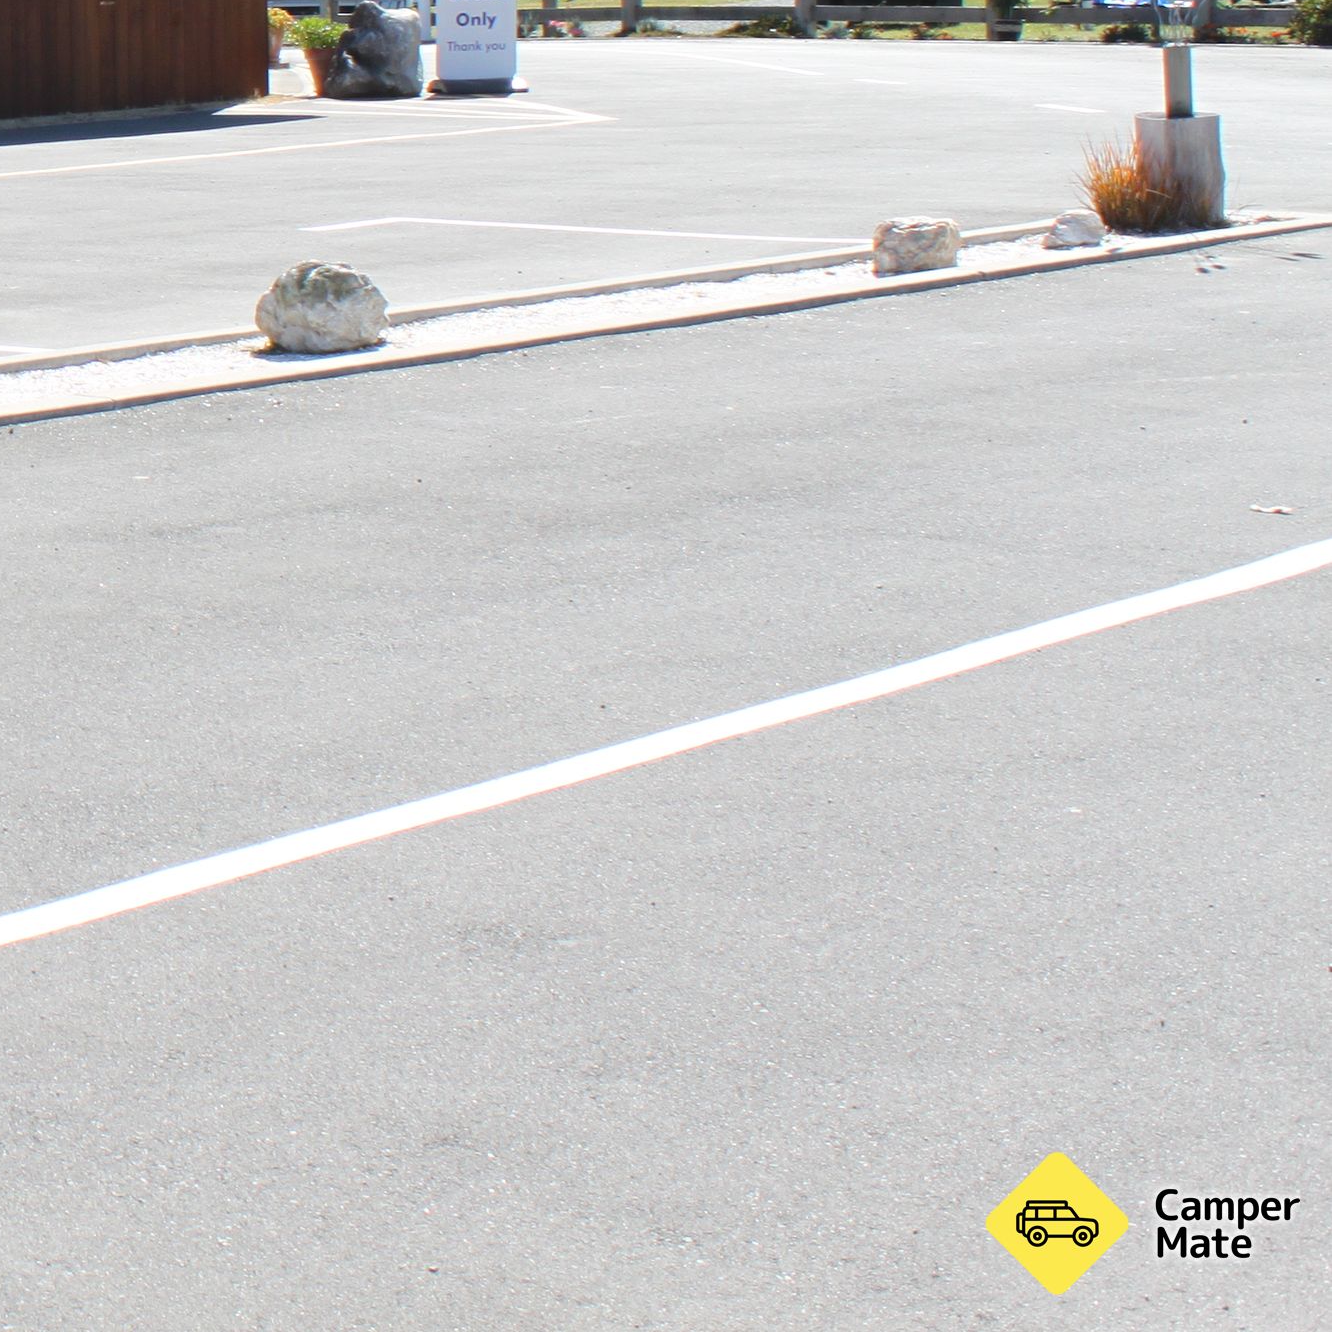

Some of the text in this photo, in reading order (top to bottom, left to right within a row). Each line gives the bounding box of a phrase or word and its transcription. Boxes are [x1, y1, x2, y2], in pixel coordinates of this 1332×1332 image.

[456, 12, 496, 29] Only
[447, 41, 506, 54] Thank you
